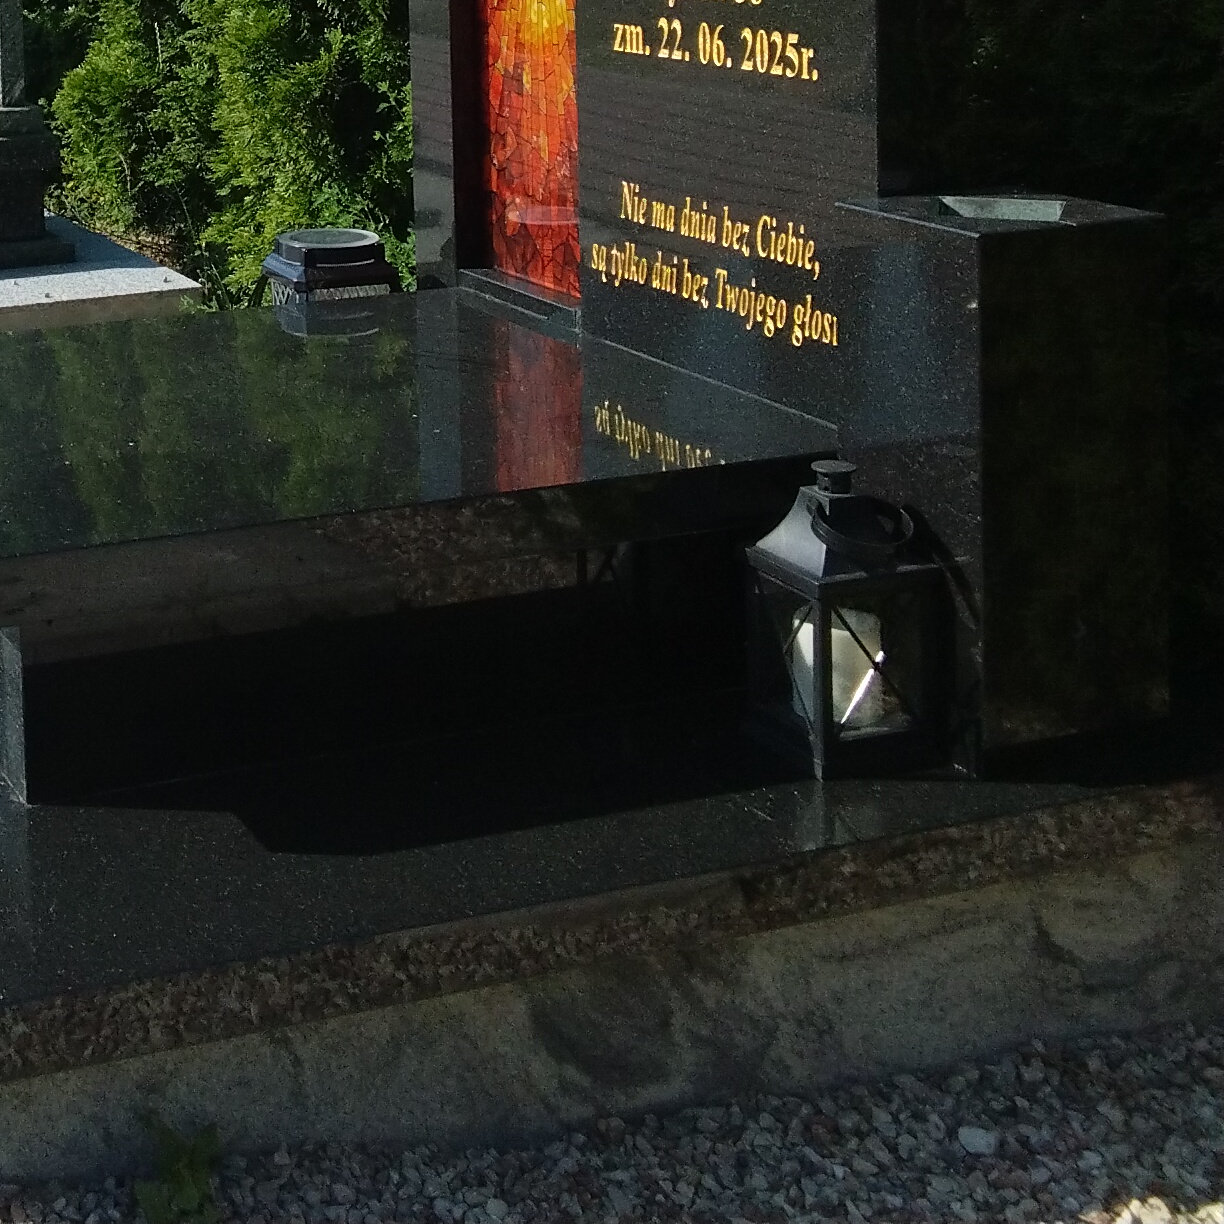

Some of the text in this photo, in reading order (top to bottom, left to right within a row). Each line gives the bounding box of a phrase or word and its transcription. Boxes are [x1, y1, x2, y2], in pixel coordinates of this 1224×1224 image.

[613, 17, 819, 81] zm. 22. 06. 2025r.
[620, 181, 820, 280] Nie ma dnia bez Ciebie,
[591, 243, 607, 282] są
[611, 241, 648, 287] tylko
[652, 250, 678, 294] dni
[682, 258, 709, 308] bez
[715, 268, 787, 337] Twojego
